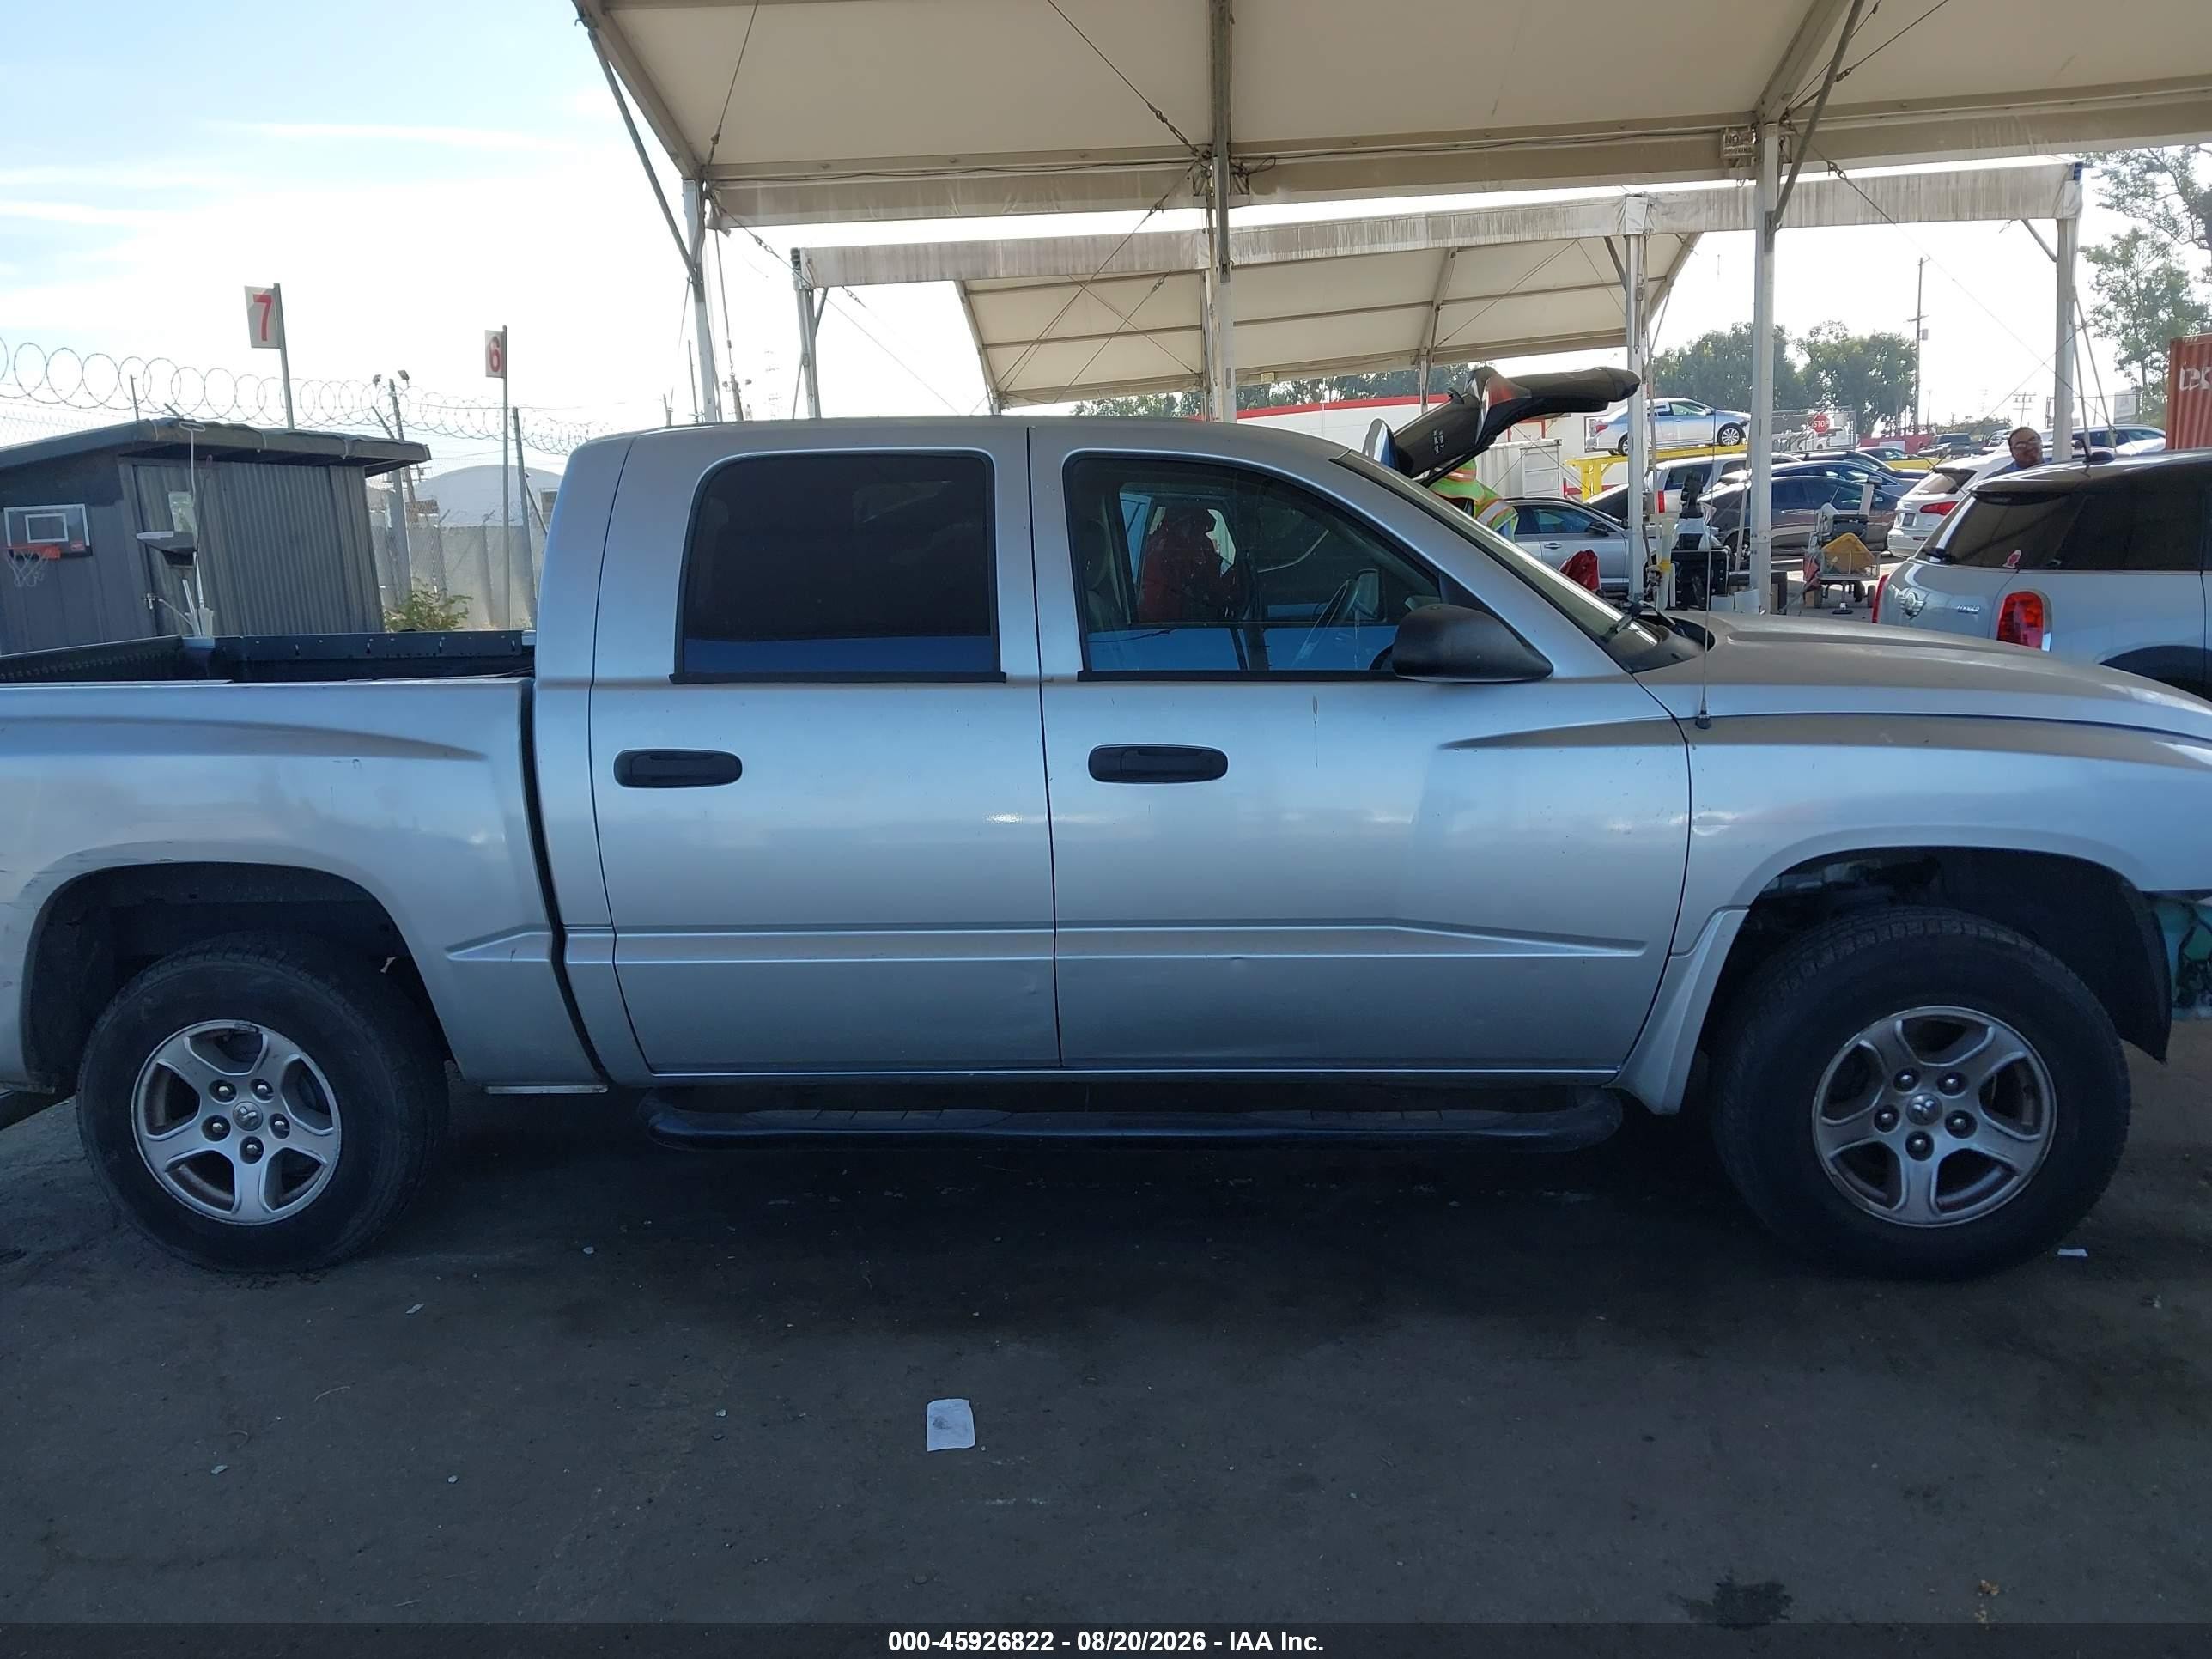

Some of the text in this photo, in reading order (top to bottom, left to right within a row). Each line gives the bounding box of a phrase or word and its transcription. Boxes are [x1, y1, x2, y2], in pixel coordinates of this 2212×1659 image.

[1725, 134, 1740, 144] NO
[252, 294, 272, 342] 7
[489, 336, 501, 372] 6
